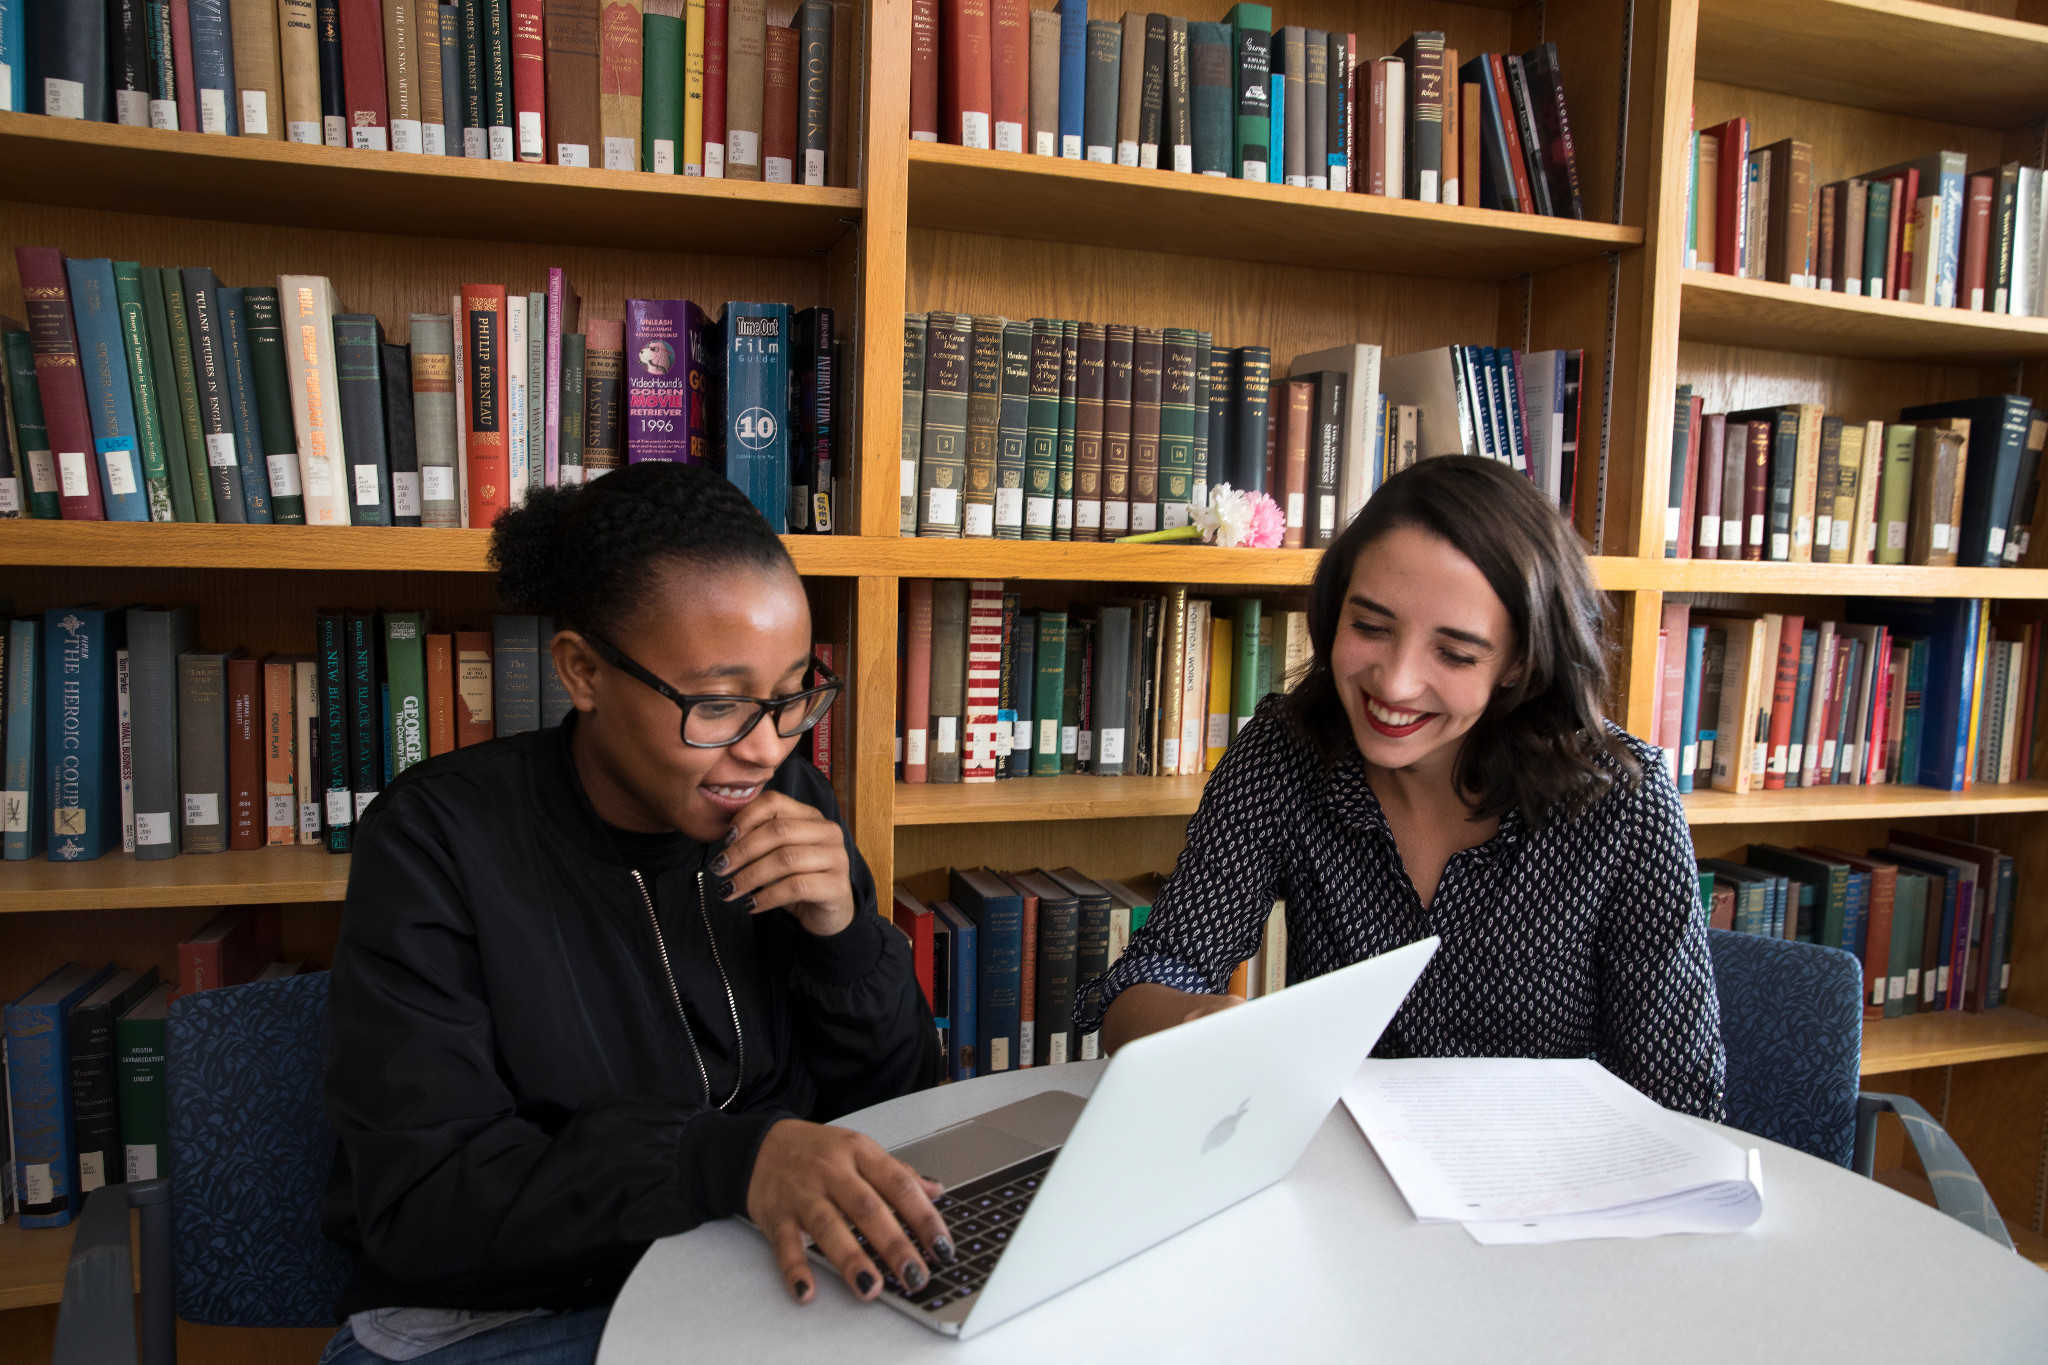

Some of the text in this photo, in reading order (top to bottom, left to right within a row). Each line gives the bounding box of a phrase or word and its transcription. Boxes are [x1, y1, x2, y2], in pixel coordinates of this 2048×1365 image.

[288, 21, 311, 29] CONRAD
[466, 0, 476, 40] ATURE'S
[490, 0, 500, 36] ATURE'S
[467, 43, 478, 91] STERNEST
[493, 40, 503, 88] STERNEST
[165, 70, 173, 100] Nightma
[808, 42, 825, 140] COOPER
[470, 95, 480, 128] PAINTE
[495, 91, 505, 126] PAINTE
[1556, 86, 1571, 150] COLORADO
[195, 290, 223, 434] TULANE STUDIES IN ENGLIS
[735, 338, 779, 353] Film
[738, 354, 776, 363] Guide
[478, 316, 492, 426] PHILIP FRENEAU
[630, 377, 683, 388] VideoHound's
[630, 395, 683, 408] MOVIE
[817, 356, 831, 424] INFORMATION
[105, 390, 119, 437] ALLUSIO
[590, 381, 602, 446] MASTERS
[607, 400, 617, 430] THE
[630, 408, 682, 417] RETRIEVER
[641, 419, 674, 432] 1996
[739, 416, 775, 438] 10
[818, 426, 829, 434] IN
[817, 497, 827, 526] USED
[1004, 611, 1013, 645] Dickens
[63, 637, 80, 674] THE
[327, 650, 338, 682] NEW
[357, 650, 368, 682] NEW
[510, 660, 525, 669] The
[1186, 605, 1197, 693] POETICAL WORKS
[119, 657, 128, 695] Tom Parker
[1002, 658, 1012, 698] Pickwick
[63, 681, 80, 750] HEROIC
[272, 713, 280, 736] FOUR
[329, 686, 340, 728] BLACK
[358, 686, 369, 728] BLACK
[397, 726, 405, 756] Country
[403, 696, 422, 762] GEORGE
[121, 721, 132, 780] SMALL BUSINESS
[271, 736, 279, 759] PLAYS
[330, 733, 343, 793] PLAYWR
